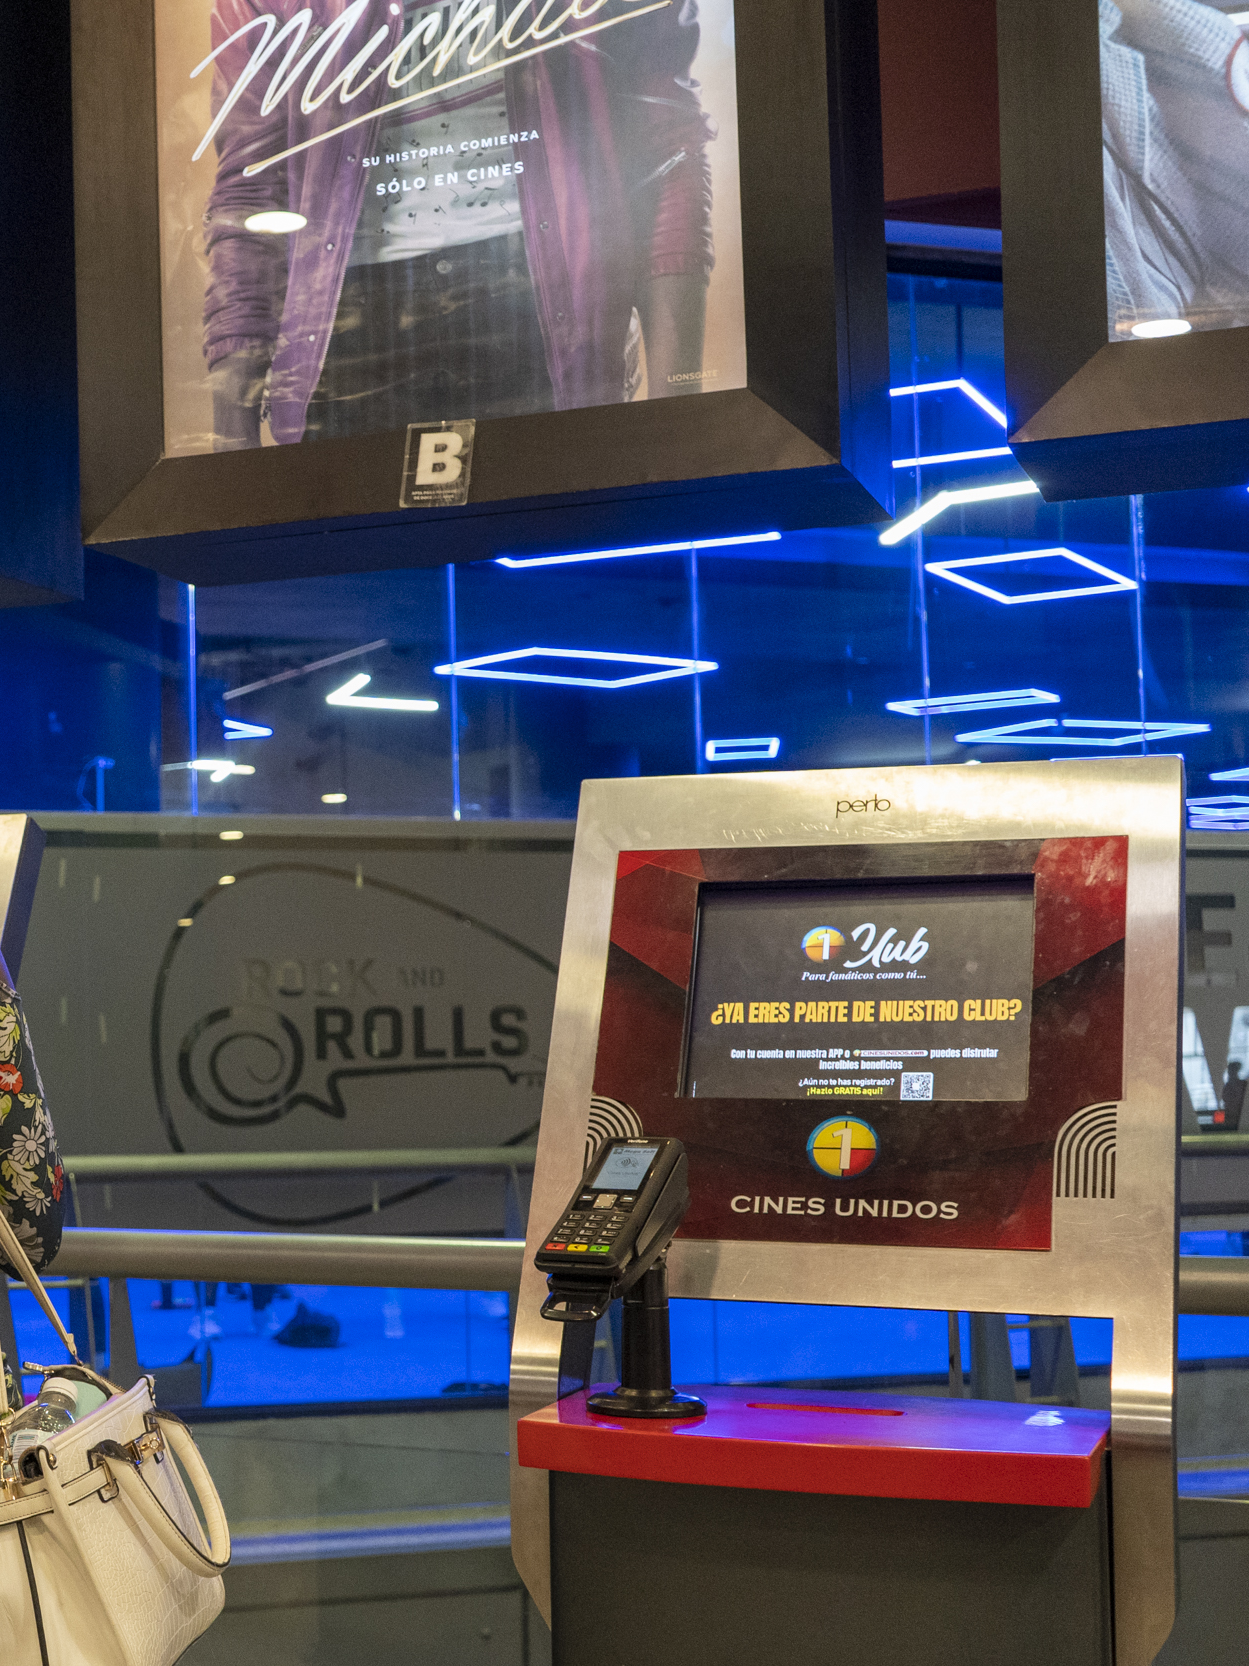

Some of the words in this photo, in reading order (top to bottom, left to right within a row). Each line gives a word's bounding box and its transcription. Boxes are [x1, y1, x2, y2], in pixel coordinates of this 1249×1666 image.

[362, 155, 381, 168] SU
[385, 144, 455, 164] HISTORIA
[460, 130, 540, 151] COMIENZA
[376, 178, 426, 196] SÓLO
[434, 171, 459, 187] EN
[467, 161, 525, 182] CINES
[667, 369, 718, 383] LIONSGATE
[415, 431, 463, 486] B
[801, 971, 826, 981] Para
[826, 970, 874, 982] fanáticos
[876, 972, 904, 980] como
[906, 969, 927, 979] tú...
[711, 1002, 744, 1025] ¿YA
[748, 1001, 791, 1023] ERES
[794, 1001, 849, 1023] PARTE
[852, 1000, 876, 1022] DE
[879, 999, 959, 1022] NUESTRO
[963, 998, 1023, 1021] CLUB?
[314, 1003, 530, 1061] ROLLS
[730, 1048, 746, 1059] Con
[747, 1049, 755, 1059] tu
[756, 1049, 784, 1059] cuenta
[785, 1050, 795, 1059] en
[796, 1049, 827, 1059] nuestra
[828, 1048, 843, 1059] APP
[844, 1050, 851, 1058] o
[930, 1047, 961, 1059] puedes
[962, 1047, 999, 1058] disfrutar
[860, 1059, 903, 1070] beneficios
[798, 1077, 818, 1087] ¿Aún
[829, 1078, 837, 1086] te
[838, 1078, 851, 1086] has
[852, 1077, 895, 1087] registrado?
[807, 1087, 833, 1096] ¡Hazlo
[834, 1087, 861, 1095] GRATIS
[862, 1087, 884, 1096] aquí!
[831, 1128, 853, 1170] 1
[730, 1195, 826, 1216] CINES
[835, 1198, 959, 1220] UNIDOS
